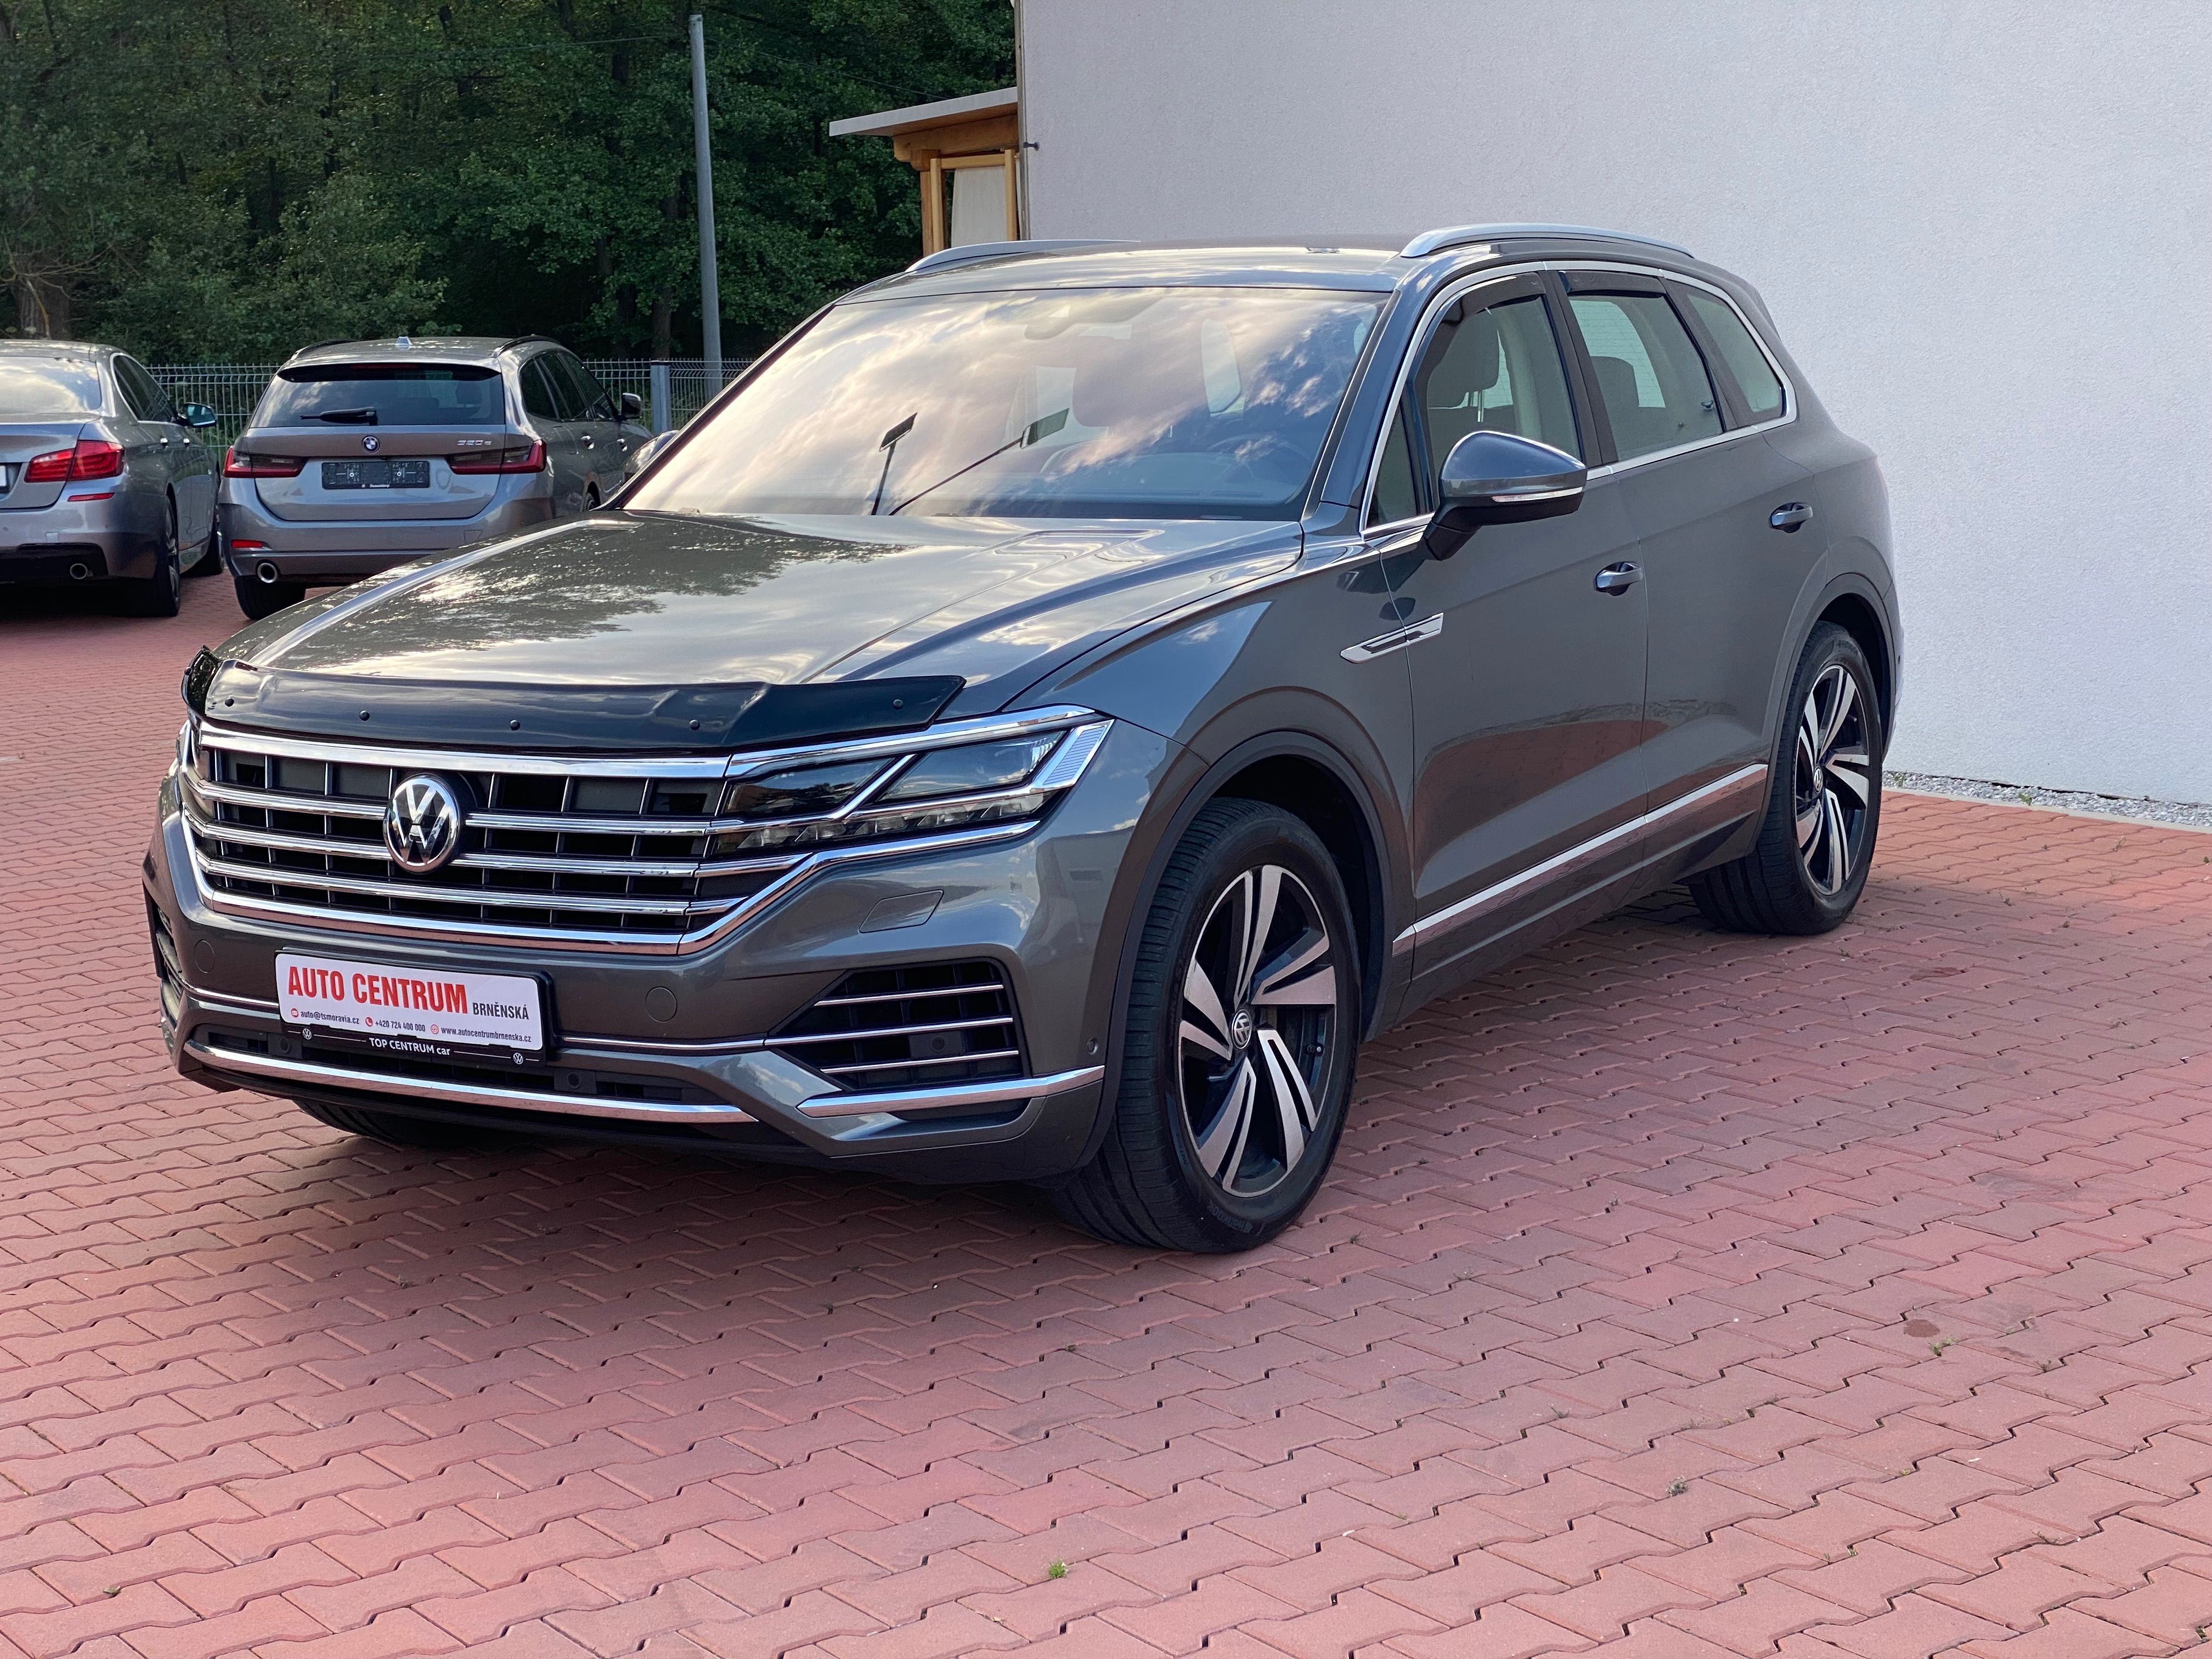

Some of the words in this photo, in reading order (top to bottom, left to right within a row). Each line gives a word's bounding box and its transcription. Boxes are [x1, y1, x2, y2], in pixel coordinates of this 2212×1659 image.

[288, 966, 345, 1001] AUTO
[352, 973, 468, 1014] CENTRUM
[300, 1010, 360, 1024] auto@tsmoravia.cz
[472, 1001, 529, 1020] BRNĚNSKÁ
[375, 1019, 390, 1028] +420
[391, 1021, 402, 1030] 724
[403, 1022, 413, 1031] 400
[415, 1024, 426, 1032] 000
[441, 1027, 532, 1043] www.autocentrumbrnenska.cz
[369, 1037, 388, 1048] TOP
[390, 1040, 435, 1054] CENTRUM
[436, 1047, 450, 1056] car
